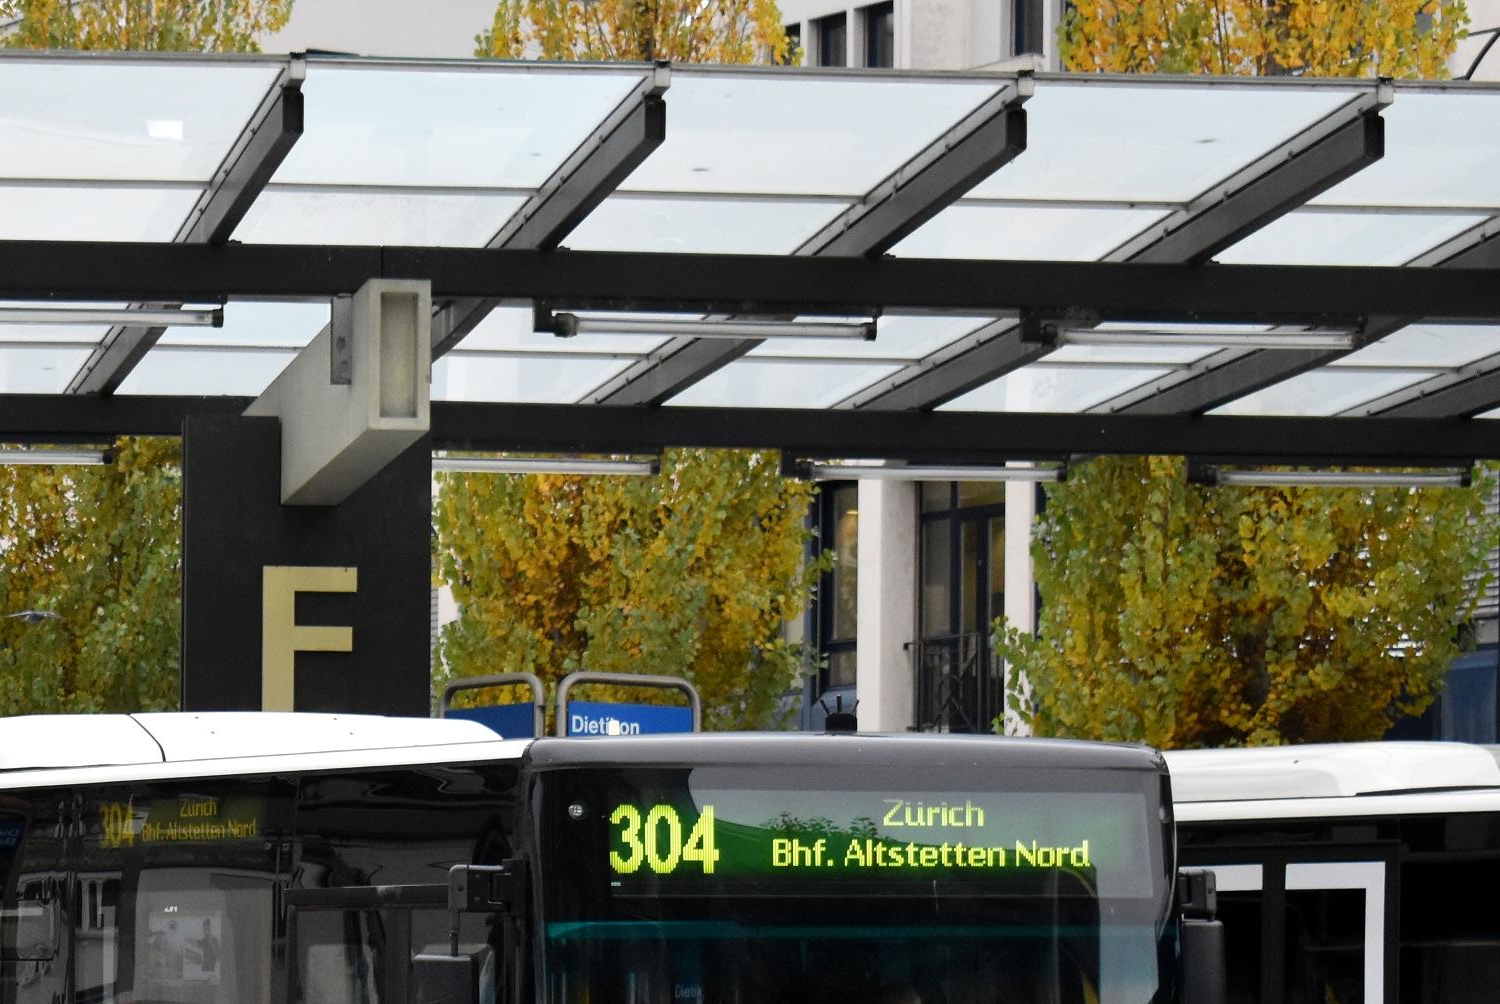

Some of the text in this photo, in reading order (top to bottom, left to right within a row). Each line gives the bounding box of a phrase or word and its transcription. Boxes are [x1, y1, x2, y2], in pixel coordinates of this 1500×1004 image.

[262, 566, 358, 712] F
[571, 715, 640, 736] Dietion
[100, 801, 135, 849] 304
[228, 817, 257, 839] Nord
[883, 799, 985, 828] Zürich
[609, 804, 720, 874] 304
[772, 838, 1091, 868] Bhf. Altstetten Nord
